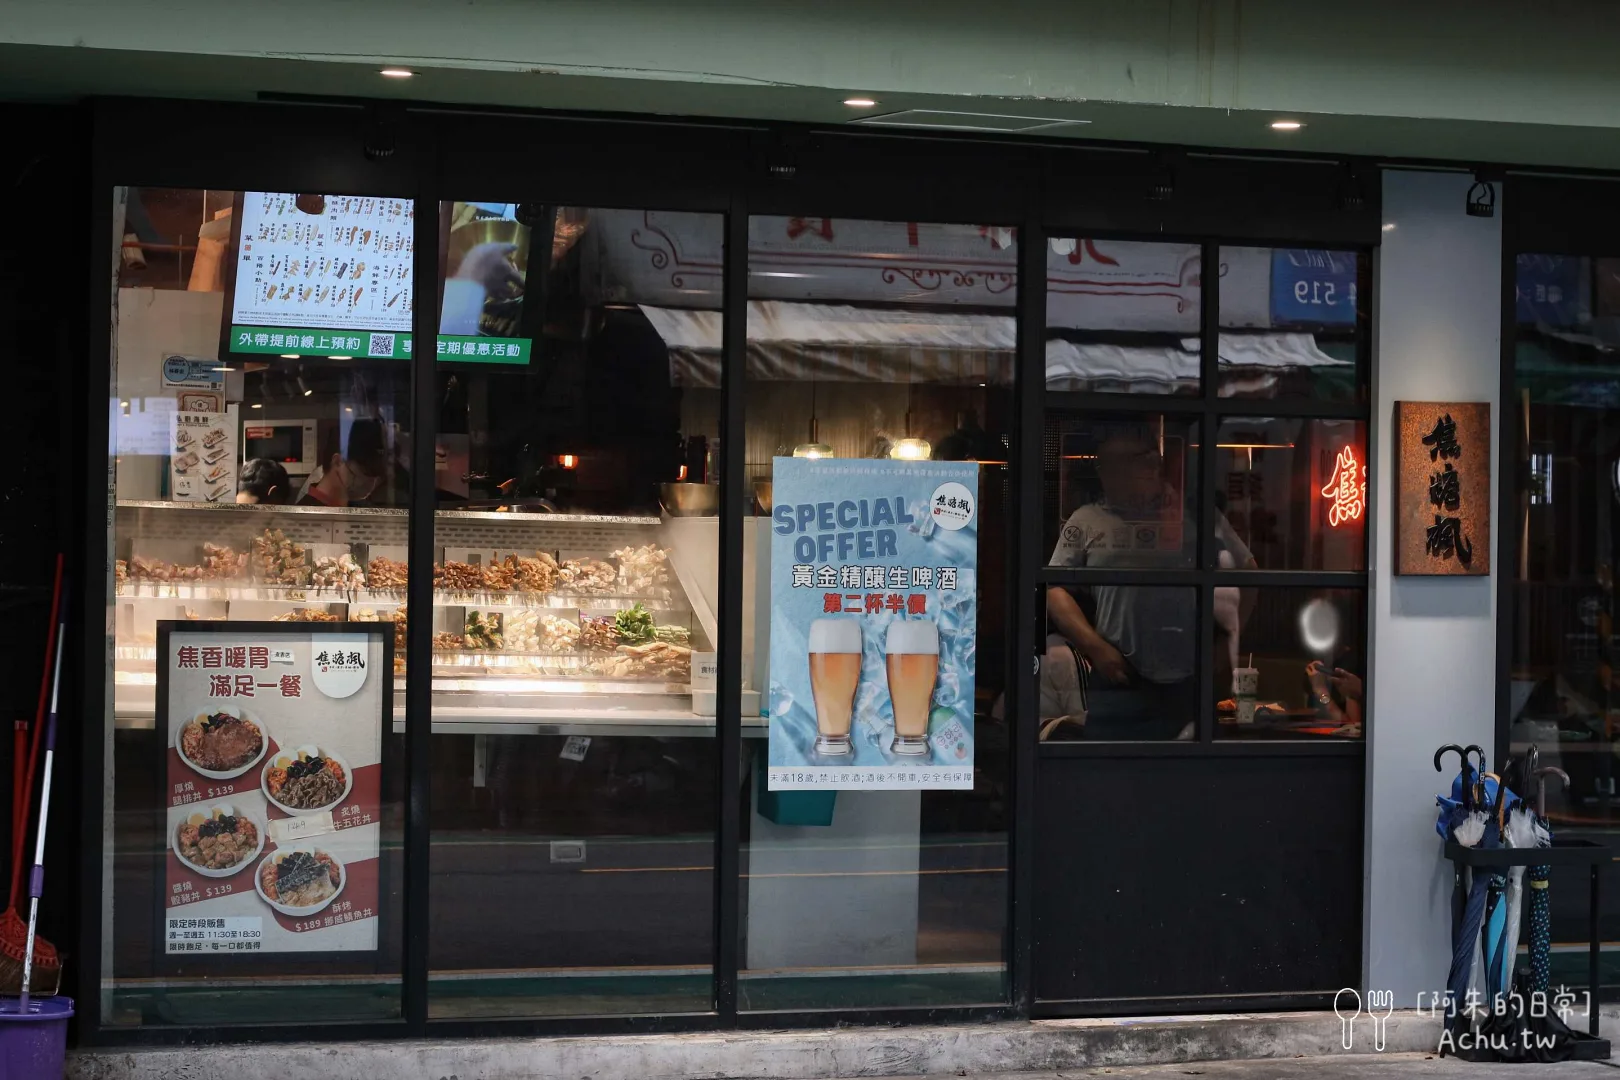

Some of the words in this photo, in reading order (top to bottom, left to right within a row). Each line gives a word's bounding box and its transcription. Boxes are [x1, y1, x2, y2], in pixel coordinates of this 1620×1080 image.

[238, 331, 361, 351] 外帶提前線上預約
[1321, 445, 1366, 527] 焦
[773, 496, 914, 536] SPECIAL
[794, 529, 898, 563] OFFER
[792, 565, 957, 590] 黃金精釀生啤酒
[823, 593, 927, 614] 第二杯半價
[176, 645, 270, 669] 焦香暖胃
[209, 674, 302, 698] 滿足一餐
[340, 804, 361, 817] 炙燒
[333, 814, 372, 830] 牛五花丼
[169, 918, 226, 929] 限定時段販售
[169, 931, 206, 939] 週一至週五
[207, 930, 261, 938] 11:30至18:30
